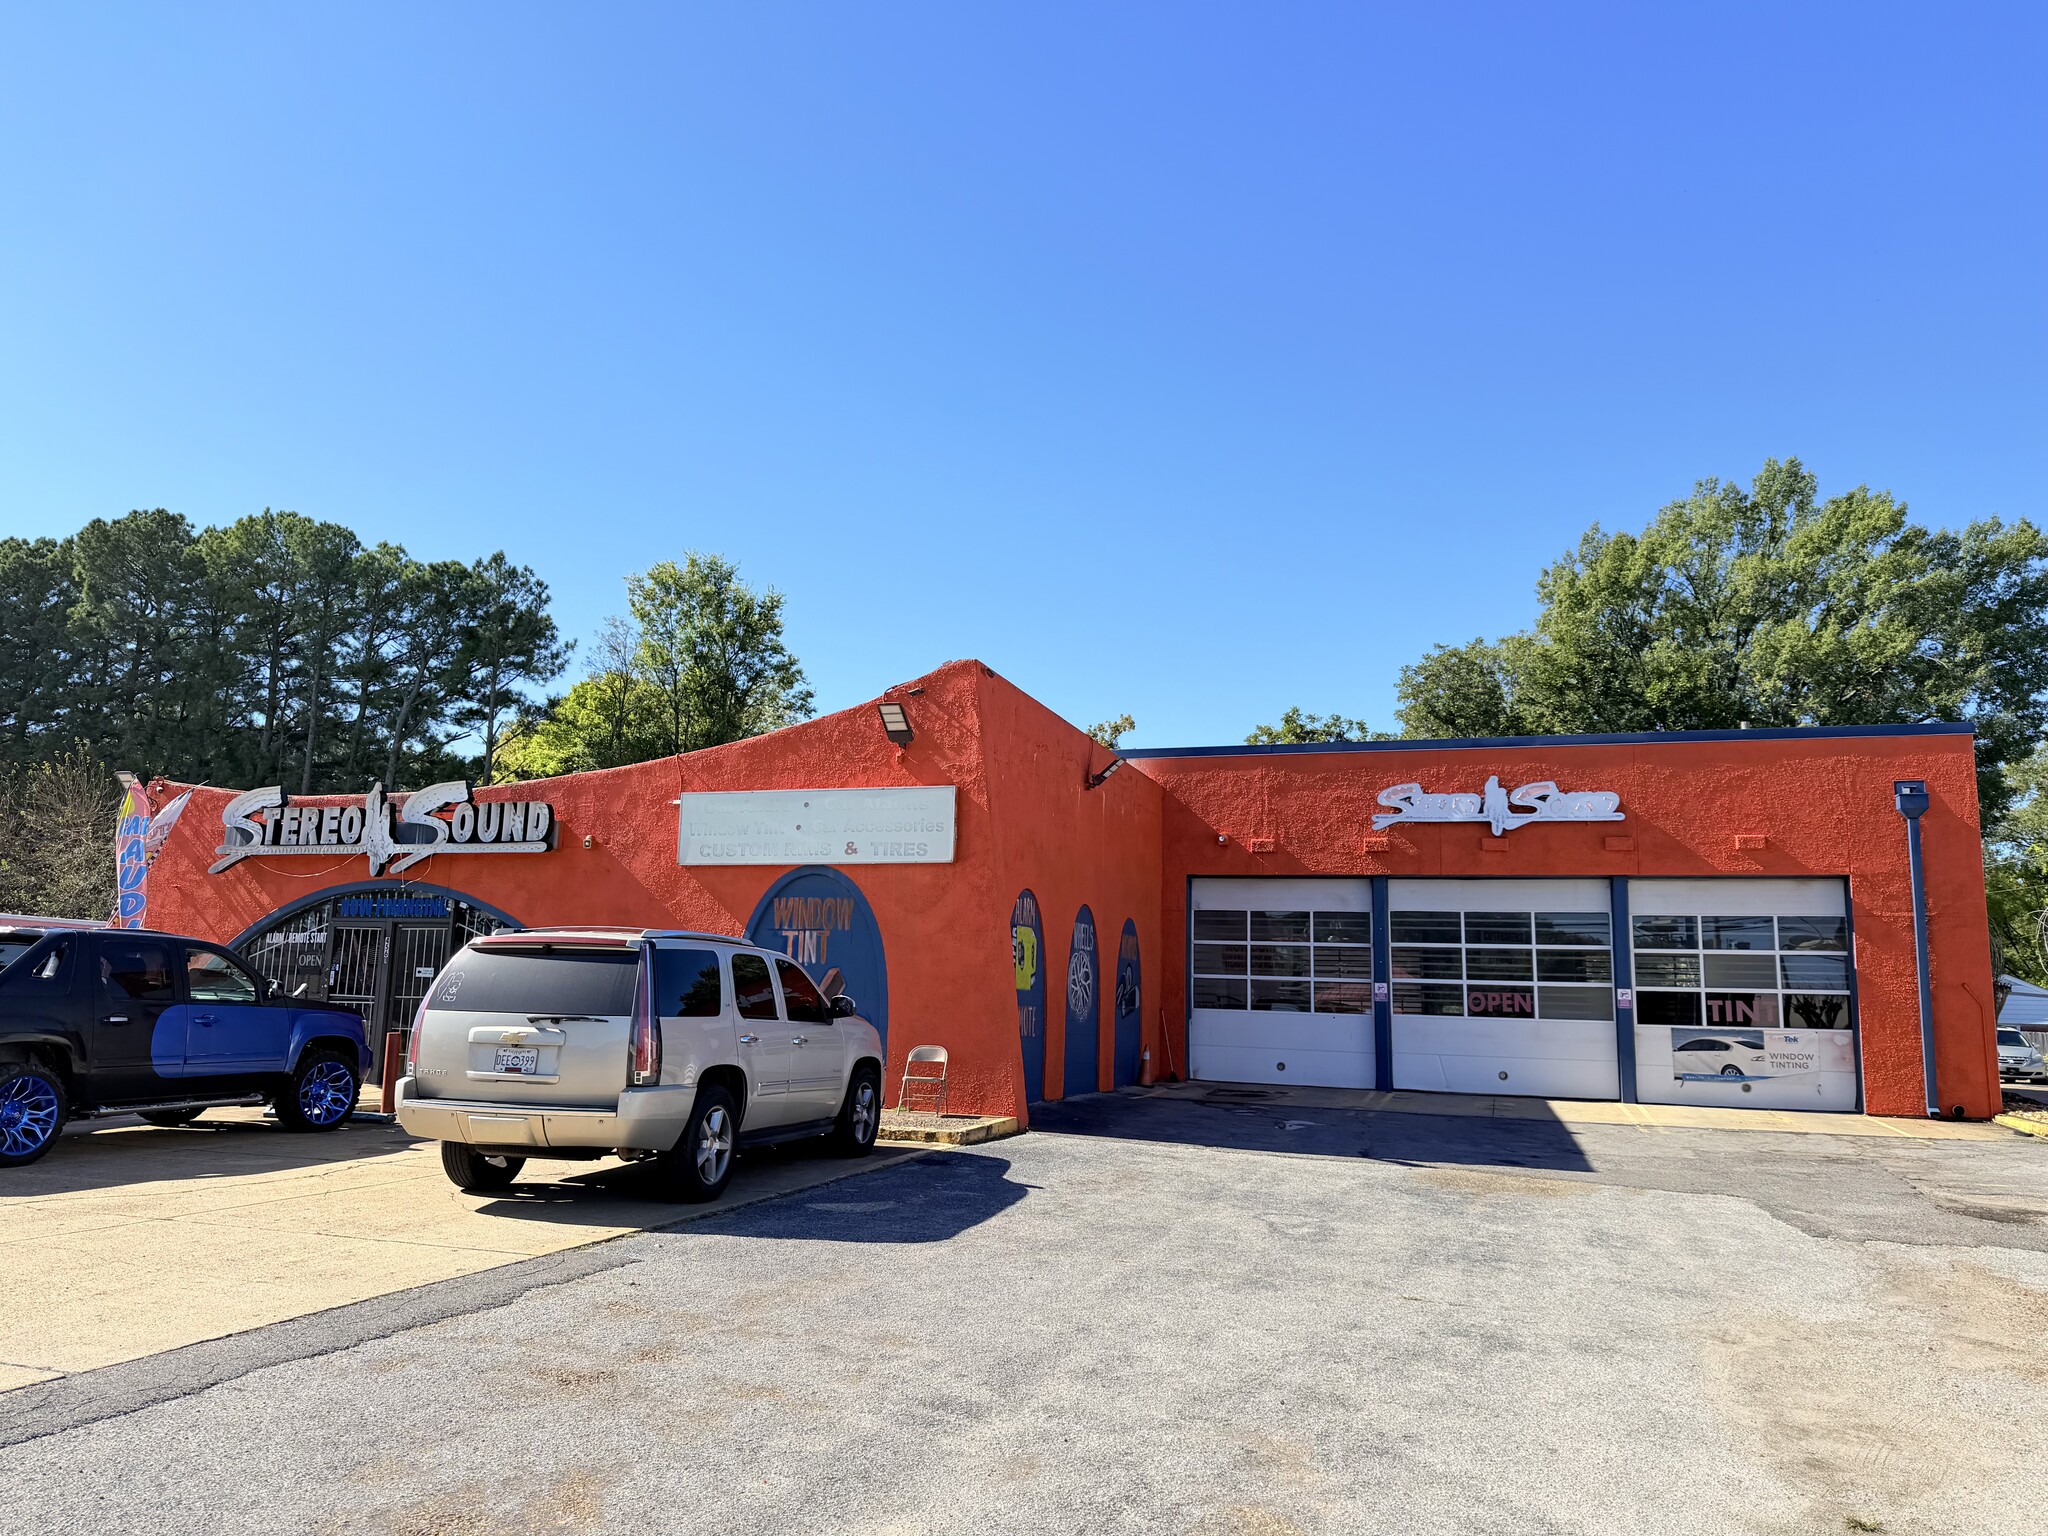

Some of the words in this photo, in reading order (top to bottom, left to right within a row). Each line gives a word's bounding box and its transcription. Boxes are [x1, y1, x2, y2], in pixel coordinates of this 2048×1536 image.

[210, 785, 363, 866] STEREO
[391, 780, 552, 866] SOUND
[699, 842, 778, 858] CUSTOM
[844, 841, 859, 856] &
[870, 841, 929, 857] TIRES
[773, 897, 855, 931] WINDOW
[311, 932, 328, 943] START
[782, 929, 830, 965] TINT
[298, 954, 323, 967] OPEN
[1468, 991, 1532, 1013] OPEN
[1707, 1000, 1777, 1022] TINT
[1769, 1052, 1815, 1061] WINDOW
[1770, 1061, 1810, 1070] TINTING
